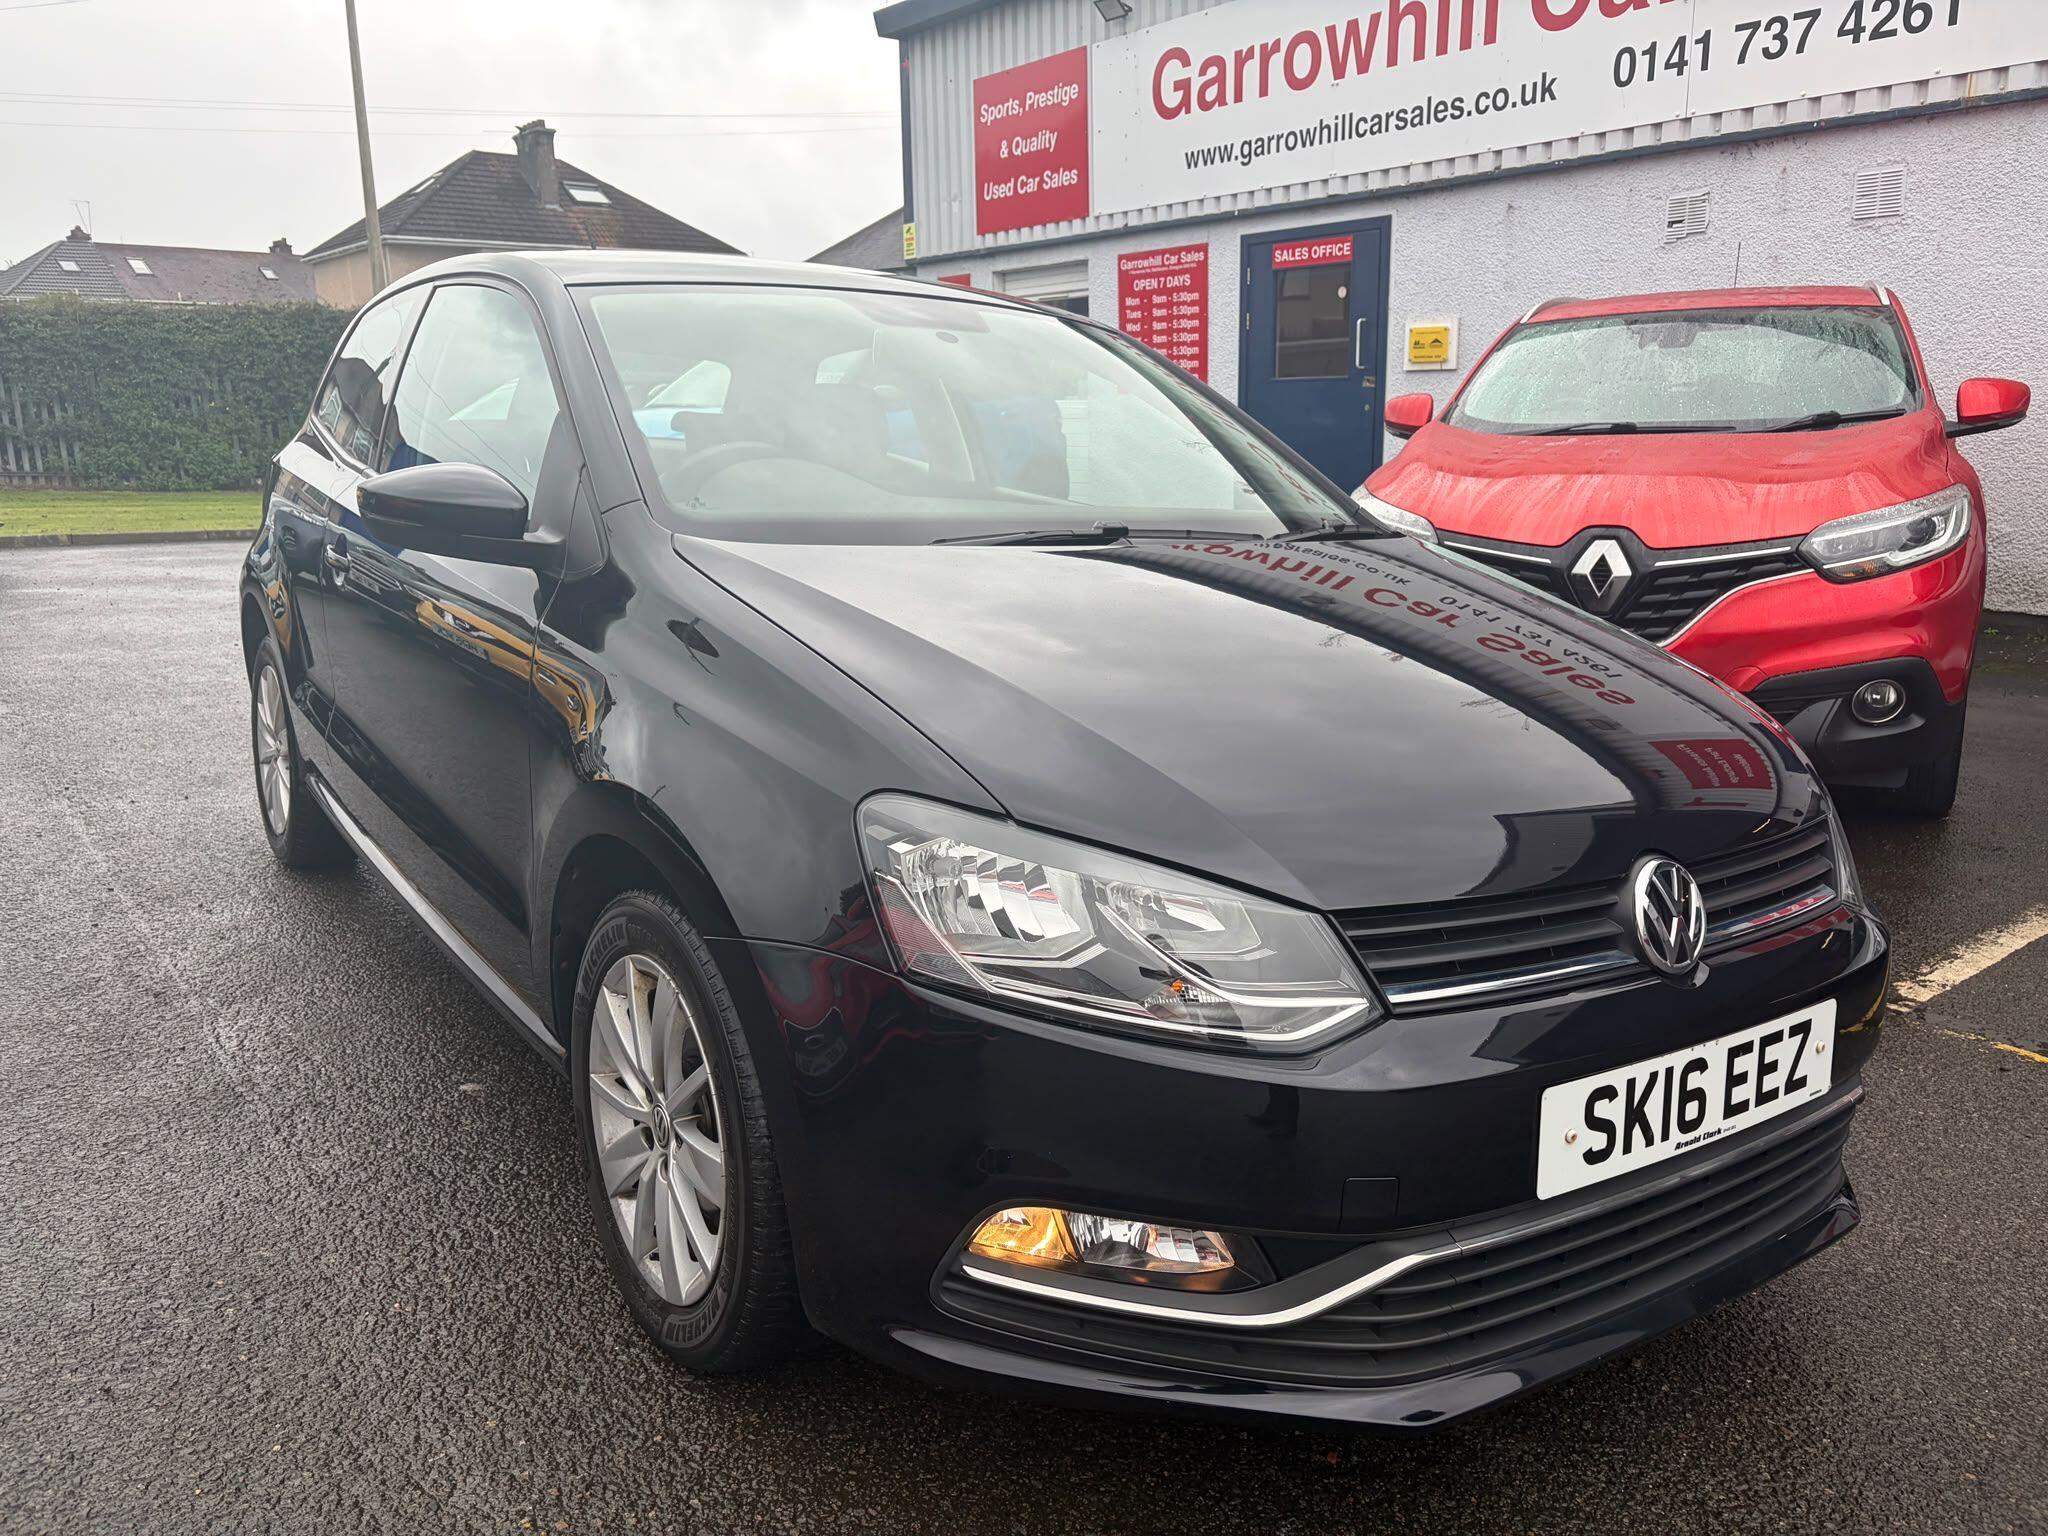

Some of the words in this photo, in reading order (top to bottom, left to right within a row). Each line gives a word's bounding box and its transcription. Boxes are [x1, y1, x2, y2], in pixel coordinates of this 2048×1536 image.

[1614, 30, 1711, 87] 0141
[1735, 8, 1821, 64] 737
[1837, 0, 1960, 44] 4261
[1153, 0, 1498, 120] Garrowhill
[980, 98, 1023, 126] Sports,
[1025, 82, 1079, 111] Prestige
[1185, 72, 1557, 169] www.garrowhillcarsales.co.uk
[1000, 140, 1009, 158] &
[1012, 129, 1057, 157] Quality
[983, 178, 1014, 201] Used
[1017, 175, 1040, 195] Car
[1042, 167, 1078, 190] Sales
[1120, 255, 1162, 270] Garrowhill
[1164, 254, 1178, 265] Car
[1180, 251, 1204, 263] Sales
[1274, 247, 1309, 263] SALES
[1311, 242, 1351, 259] OFFICE
[1133, 278, 1158, 291] OPEN
[1159, 277, 1165, 289] 7
[1166, 274, 1191, 286] DAYS
[1125, 297, 1140, 306] Mon
[1152, 294, 1167, 304] 9am
[1172, 292, 1199, 303] 5:30pm
[1126, 310, 1142, 319] Tues
[1152, 308, 1167, 317] 9am
[1172, 305, 1199, 316] 5:30pm
[1126, 322, 1140, 332] Wed
[1152, 321, 1167, 331] 9am
[1172, 319, 1199, 330] 5:30pm
[1152, 334, 1167, 344] 9am
[1172, 332, 1199, 344] 5:30pm
[1172, 346, 1199, 357] 5:30pm
[1582, 1057, 1709, 1166] SK16
[1723, 1018, 1813, 1121] EEZ
[1674, 1134, 1701, 1151] Arnold
[1702, 1128, 1722, 1141] Clark
